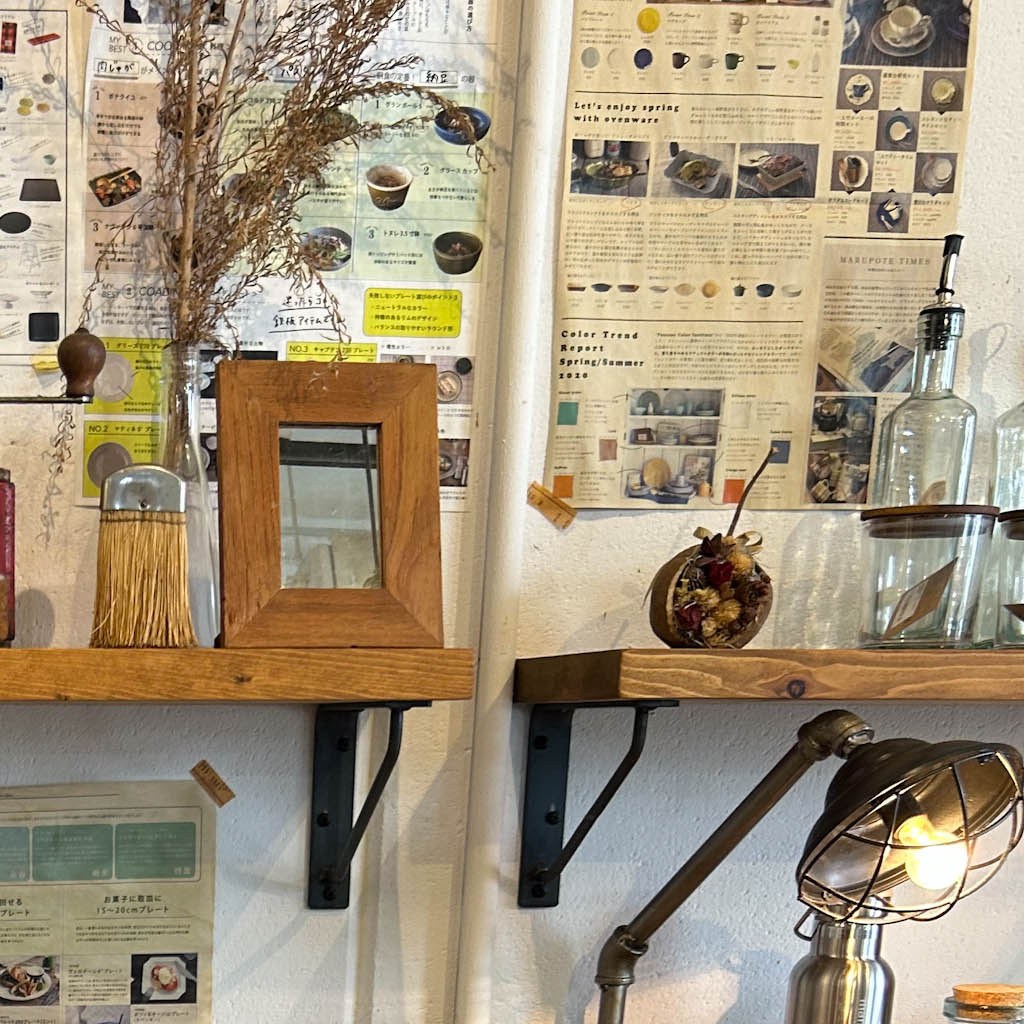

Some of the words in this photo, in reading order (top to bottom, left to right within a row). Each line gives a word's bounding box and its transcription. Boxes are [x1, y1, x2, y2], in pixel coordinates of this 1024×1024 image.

[574, 101, 602, 110] Let's
[607, 104, 638, 112] enjoy
[642, 103, 680, 112] spring
[561, 330, 596, 338] Color
[603, 330, 638, 339] Trend
[560, 344, 604, 353] Report
[559, 358, 645, 367] Spring/Summer
